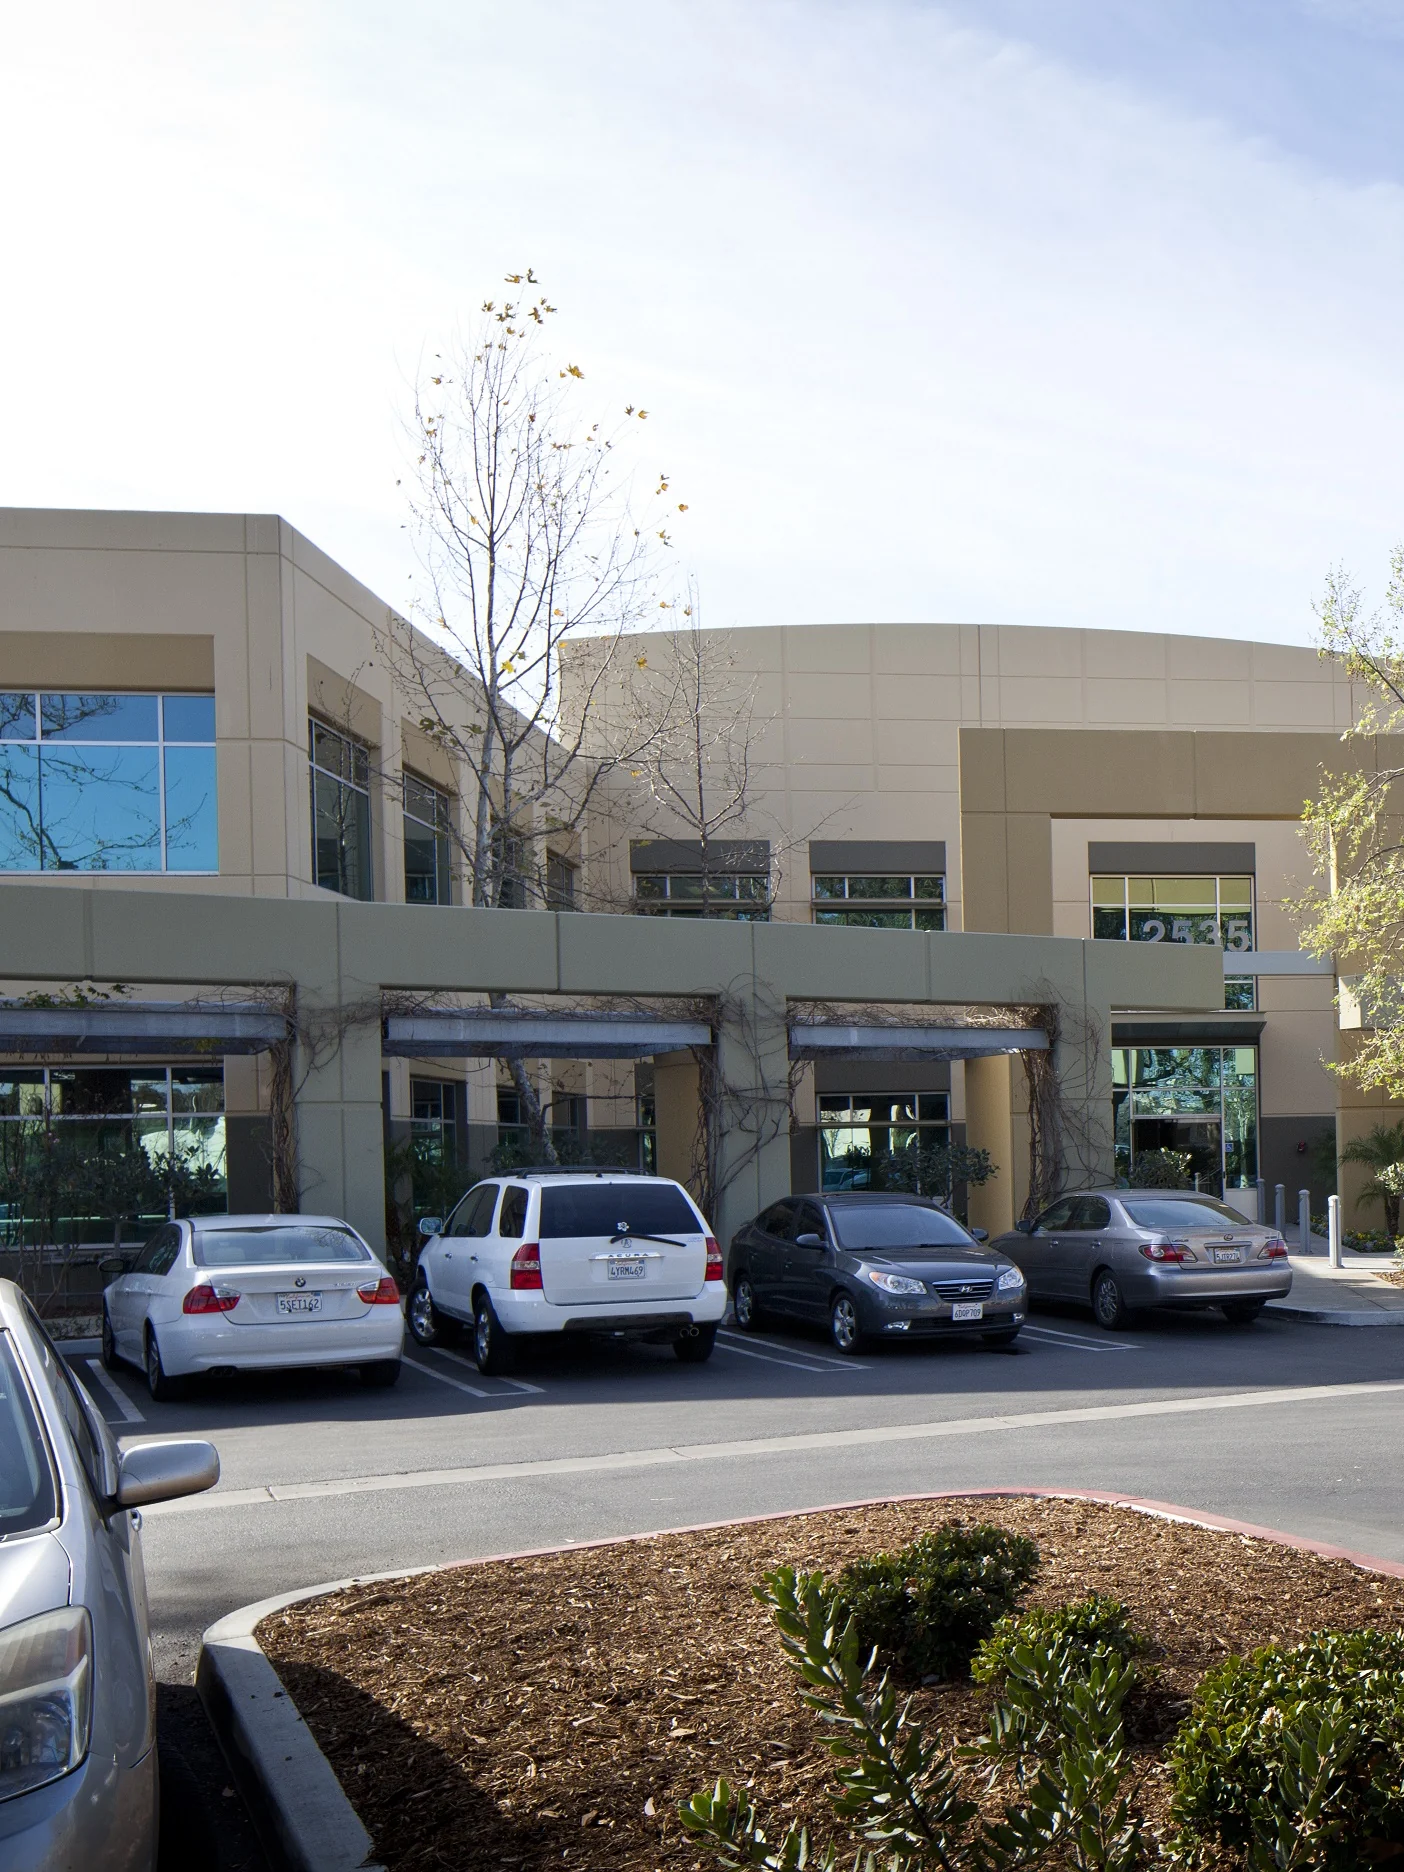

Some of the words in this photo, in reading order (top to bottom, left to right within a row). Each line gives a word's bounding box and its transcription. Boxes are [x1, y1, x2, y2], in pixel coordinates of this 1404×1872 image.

[1142, 919, 1249, 952] 2535
[610, 1266, 643, 1276] 4YRM469
[280, 1298, 319, 1310] 5SET162
